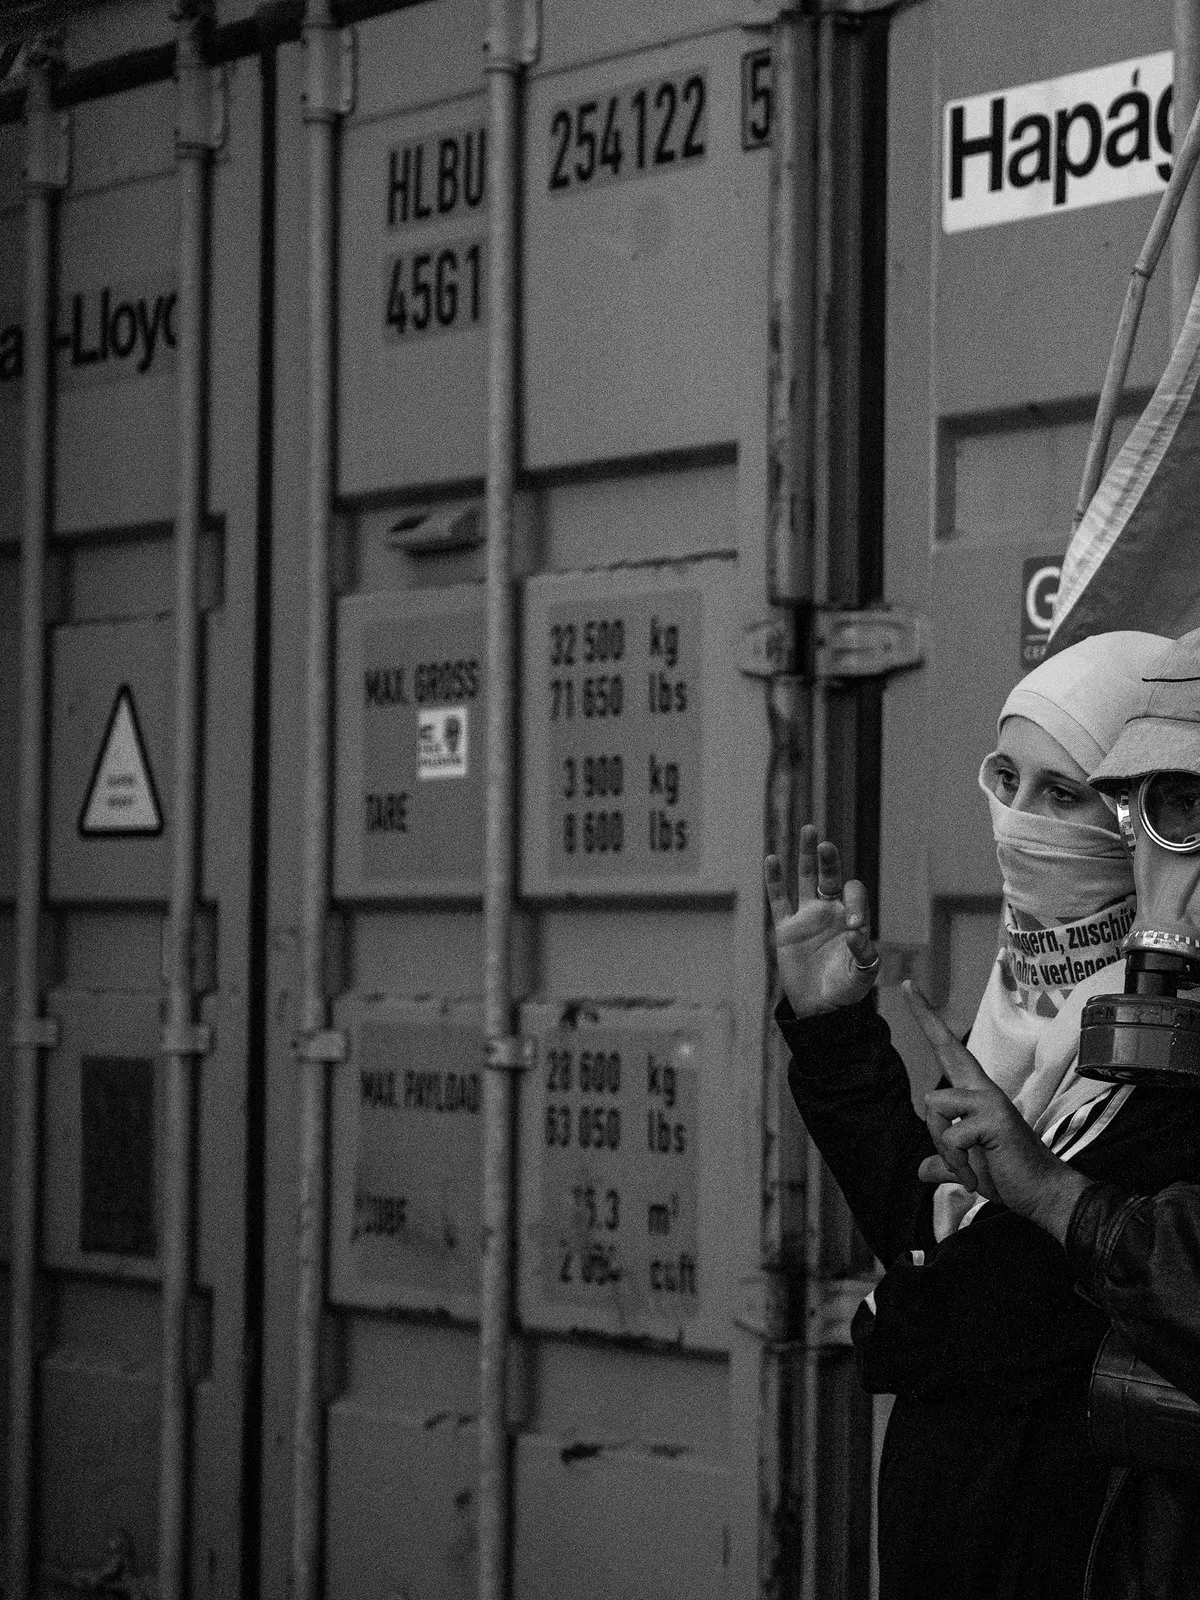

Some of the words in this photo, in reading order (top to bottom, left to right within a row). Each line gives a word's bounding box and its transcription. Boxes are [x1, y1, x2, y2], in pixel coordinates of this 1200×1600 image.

[549, 74, 706, 190] 254122
[750, 56, 772, 140] 5
[388, 128, 486, 225] HLBU
[386, 244, 481, 335] 45G1
[551, 624, 577, 666] 32
[584, 618, 625, 663] 500
[649, 617, 679, 669] kg
[550, 678, 574, 720] 71
[648, 672, 687, 713] lbs
[648, 753, 679, 806] kg
[648, 810, 688, 852] lbs
[647, 1051, 677, 1108] kg
[648, 1108, 687, 1154] lbs
